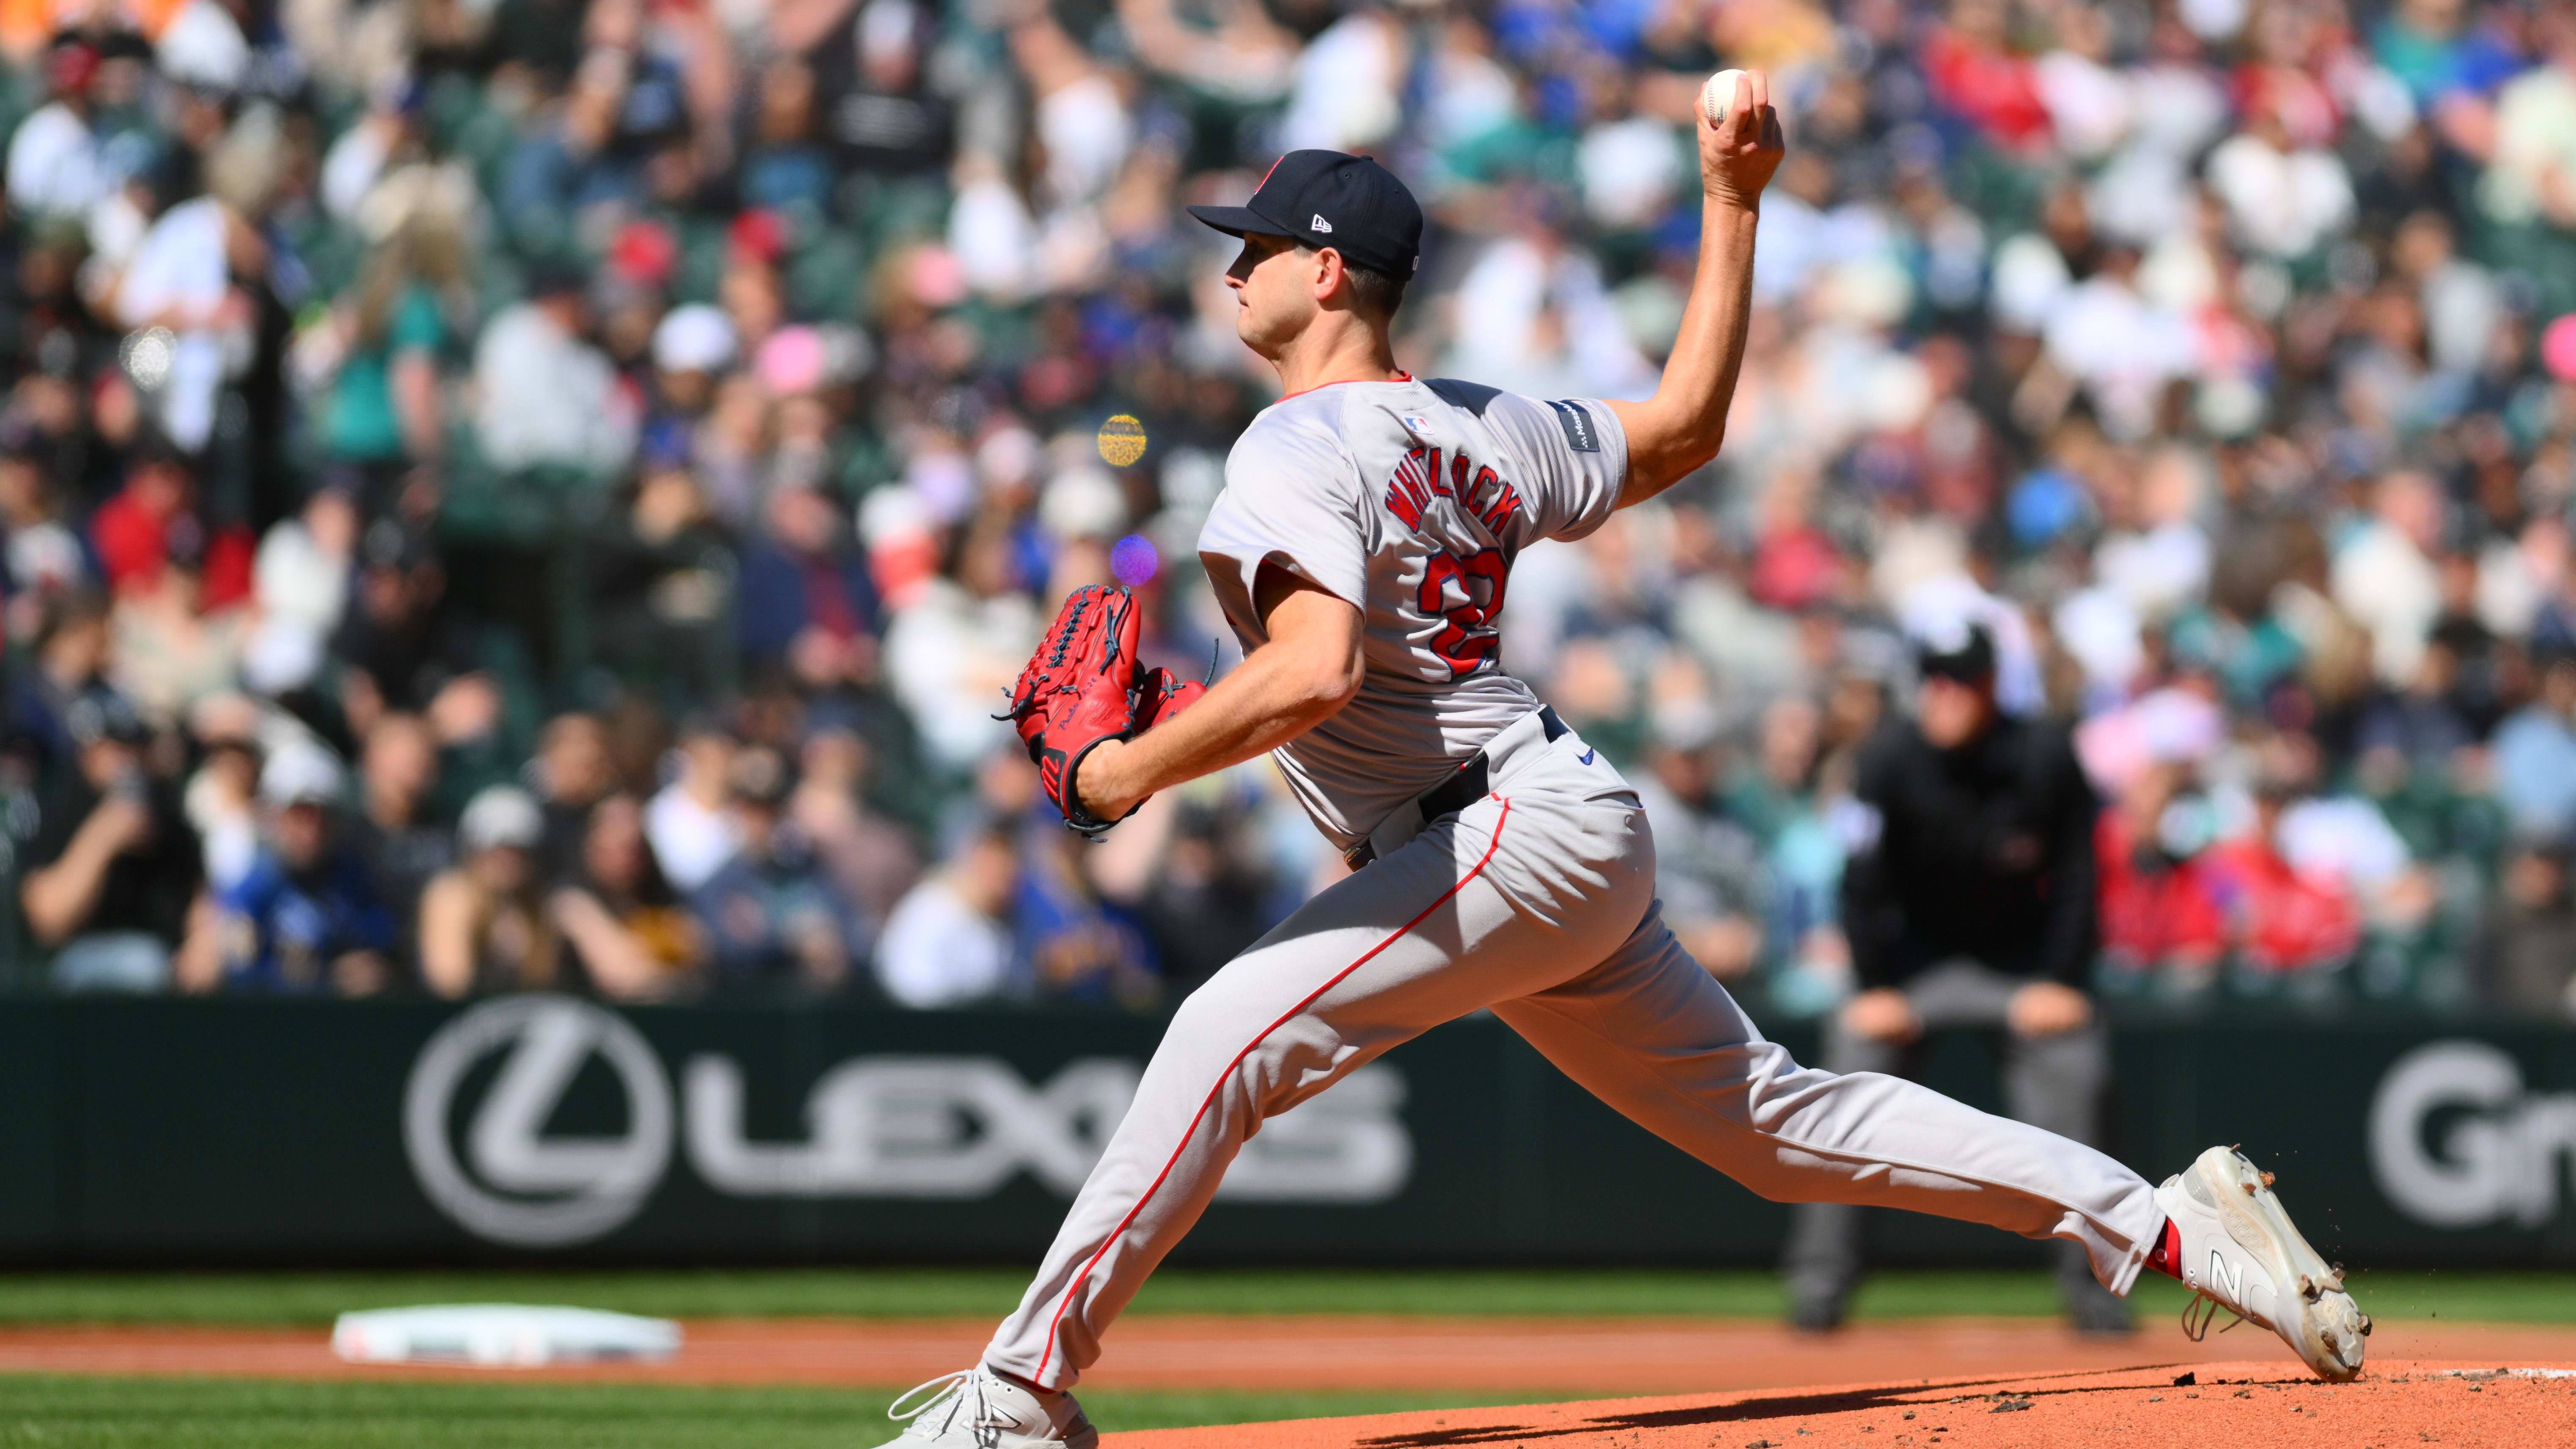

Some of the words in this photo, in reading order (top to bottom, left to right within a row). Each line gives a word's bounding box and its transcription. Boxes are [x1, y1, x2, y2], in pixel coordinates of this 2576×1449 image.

[1385, 446, 1522, 536] WHITLOCK
[1417, 547, 1508, 677] 22
[682, 1053, 1415, 1204] LEXS
[2370, 1043, 2576, 1229] Gr
